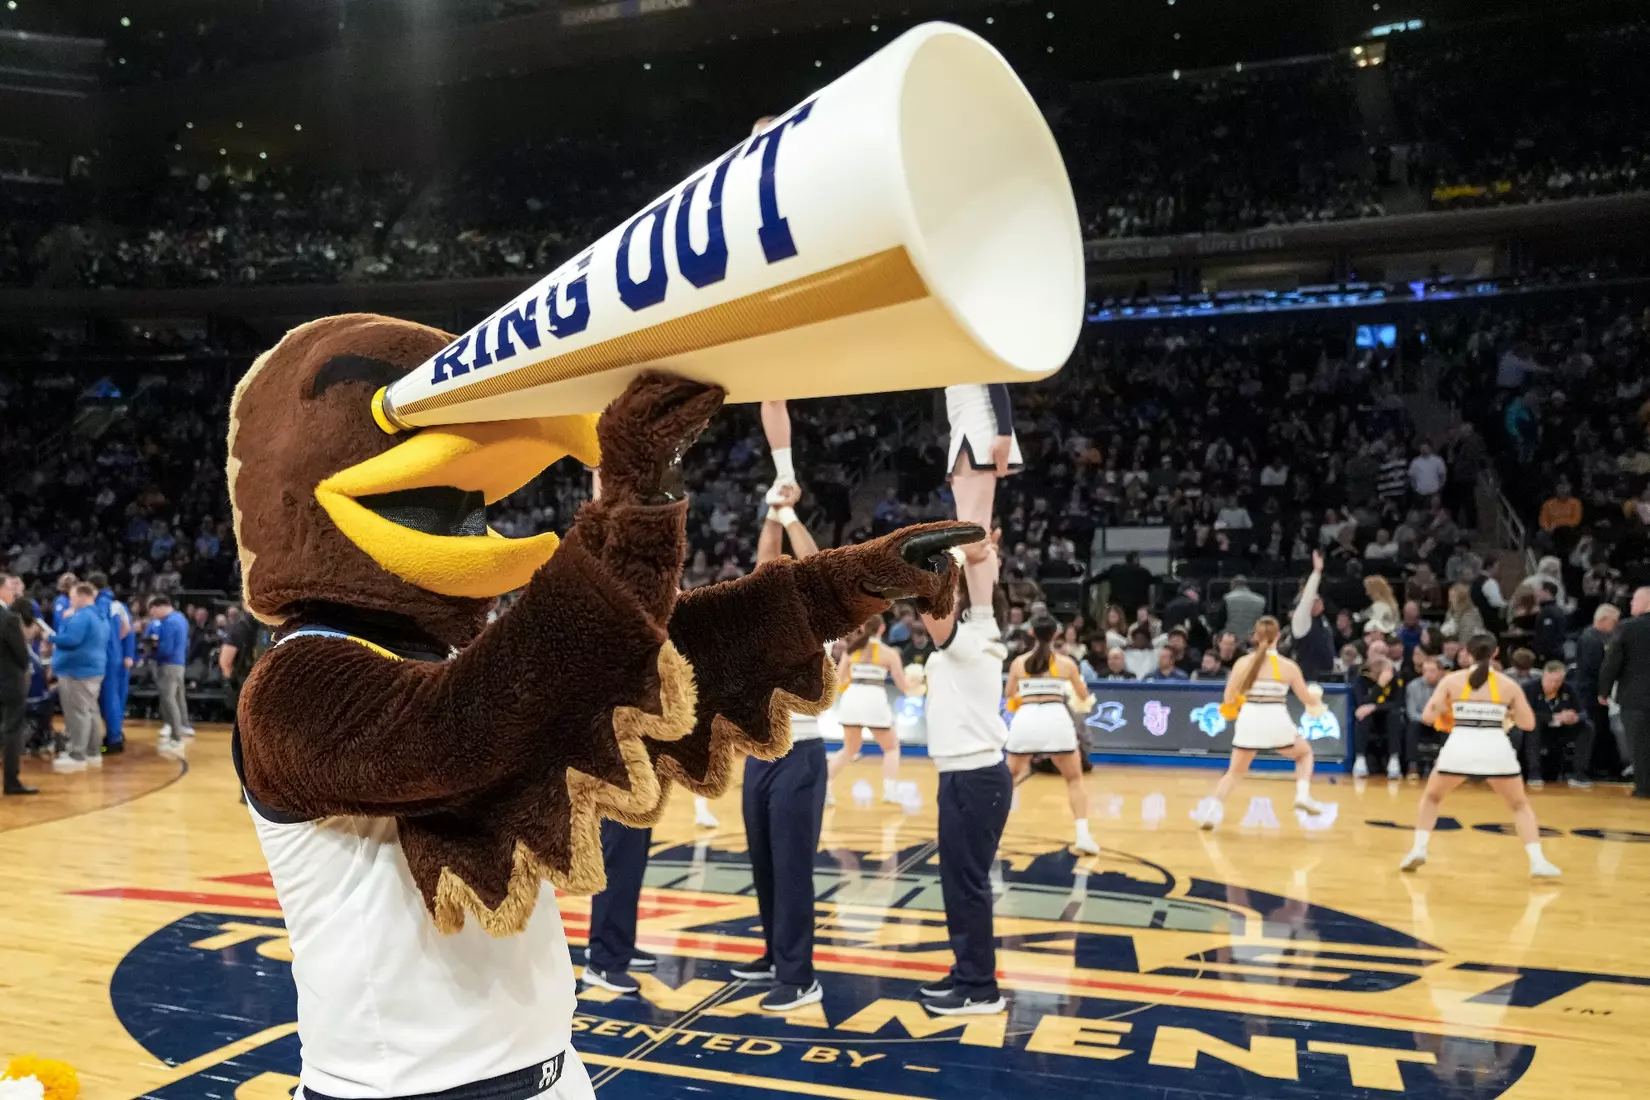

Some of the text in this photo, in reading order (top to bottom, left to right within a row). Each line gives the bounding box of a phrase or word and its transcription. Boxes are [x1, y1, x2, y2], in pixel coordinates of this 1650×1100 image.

[431, 98, 819, 385] RING OUT
[800, 1045, 886, 1068] BY
